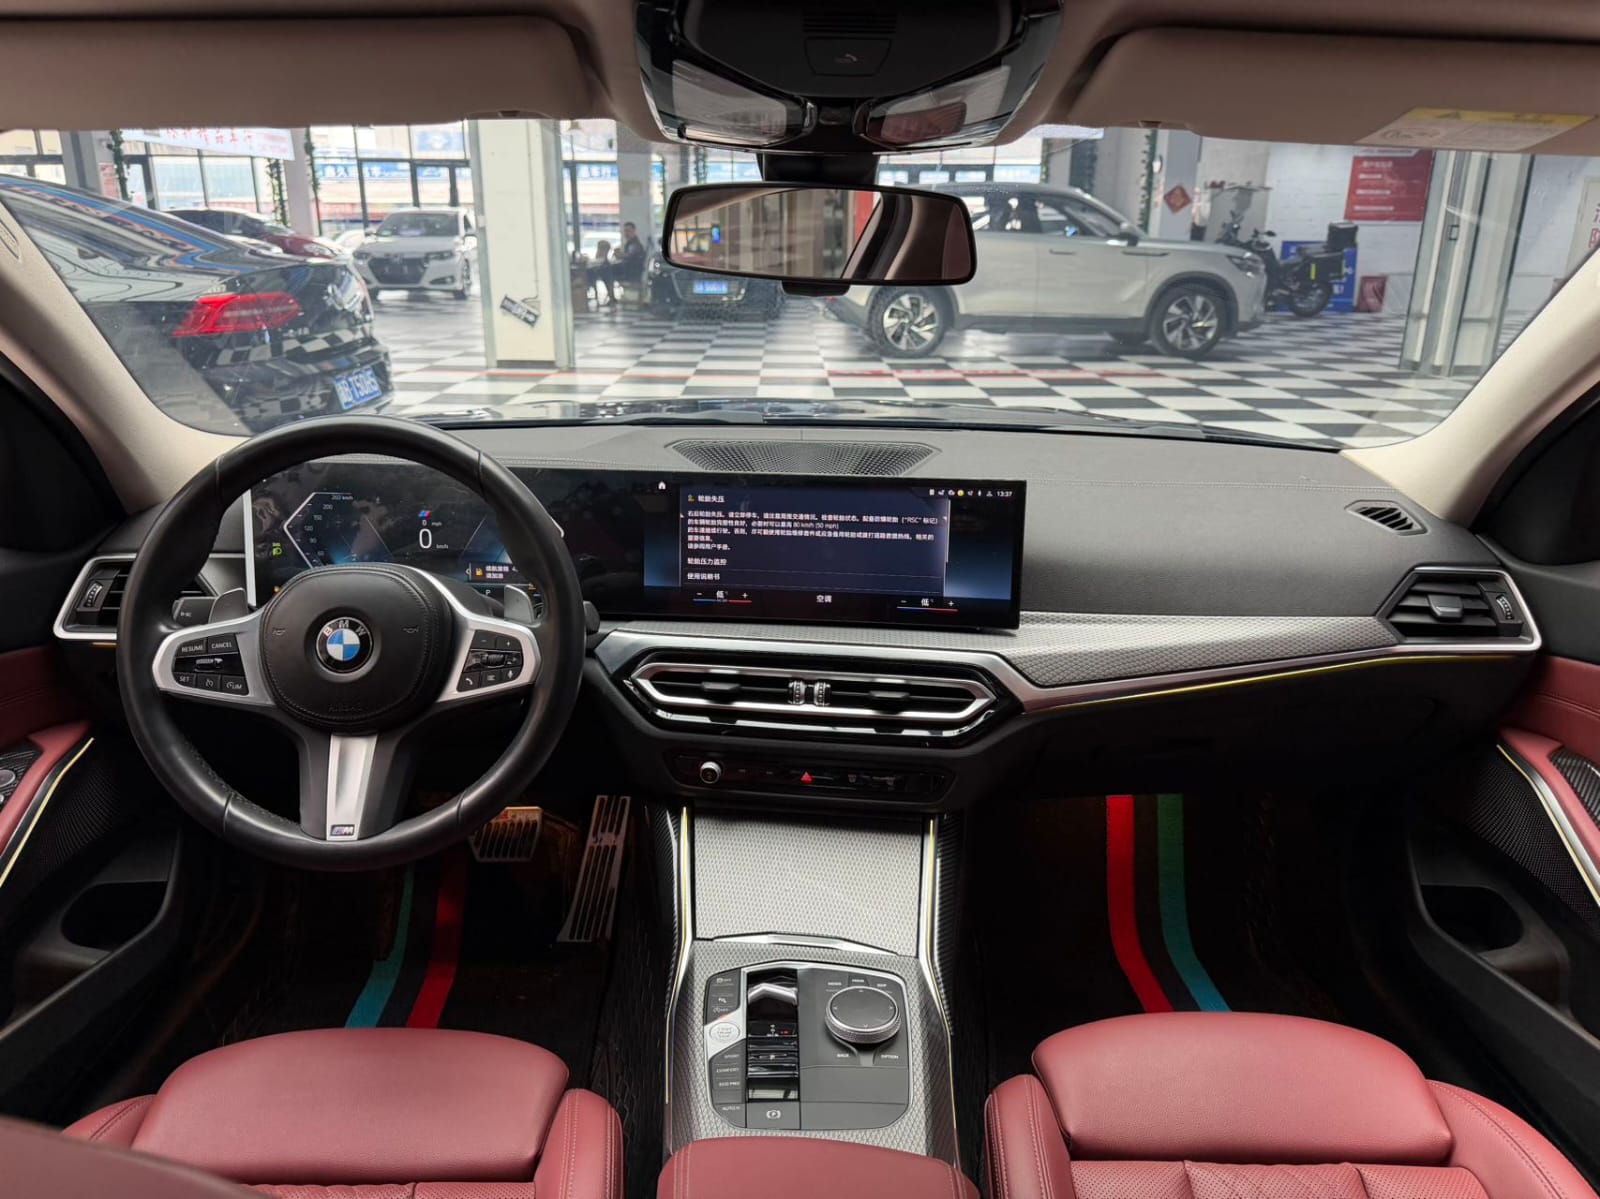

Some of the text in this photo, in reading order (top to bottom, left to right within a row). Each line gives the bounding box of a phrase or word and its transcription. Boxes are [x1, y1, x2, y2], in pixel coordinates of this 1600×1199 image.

[697, 494, 725, 503] 轮胎失压
[419, 528, 432, 549] 0
[687, 572, 720, 580] 使用说明书
[816, 594, 832, 603] 空调
[921, 598, 930, 607] 低
[323, 619, 367, 637] BMW
[181, 645, 204, 653] RESUME
[211, 641, 232, 649] CANCEL
